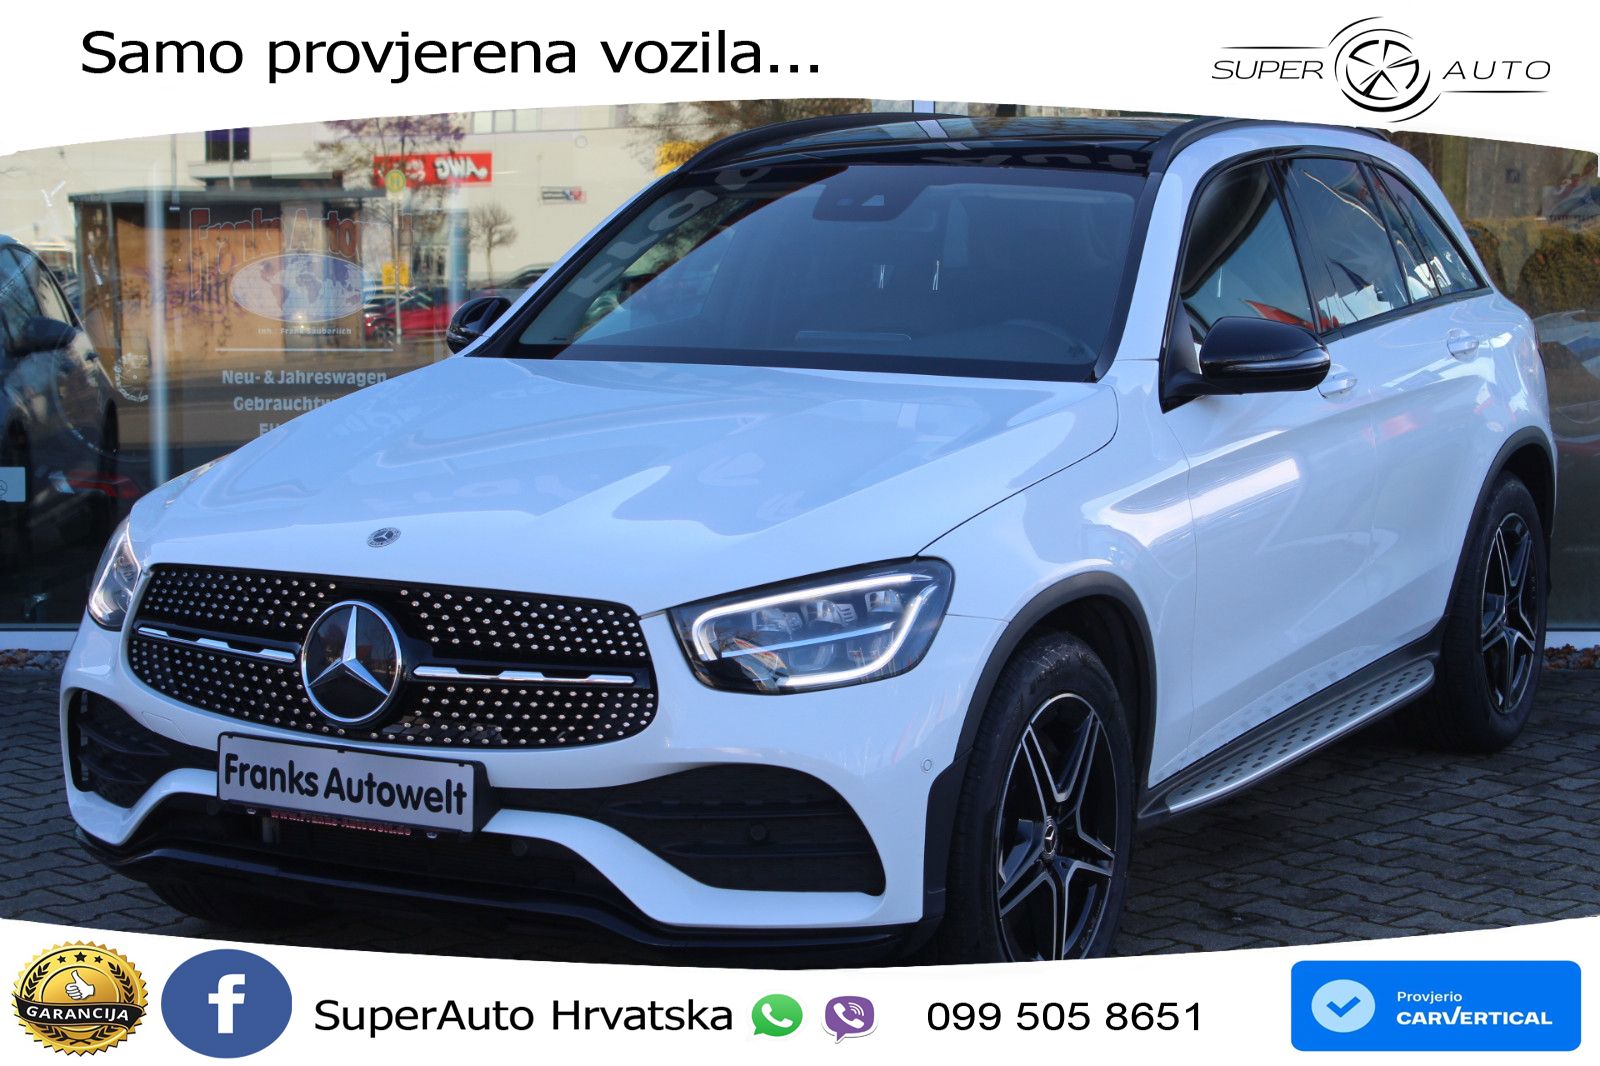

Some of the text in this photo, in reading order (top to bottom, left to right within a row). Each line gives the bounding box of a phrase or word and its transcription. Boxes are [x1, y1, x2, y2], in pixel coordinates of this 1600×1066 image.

[222, 369, 388, 387] Neu- & Jahreswagen
[224, 753, 467, 815] Franks Autowelt
